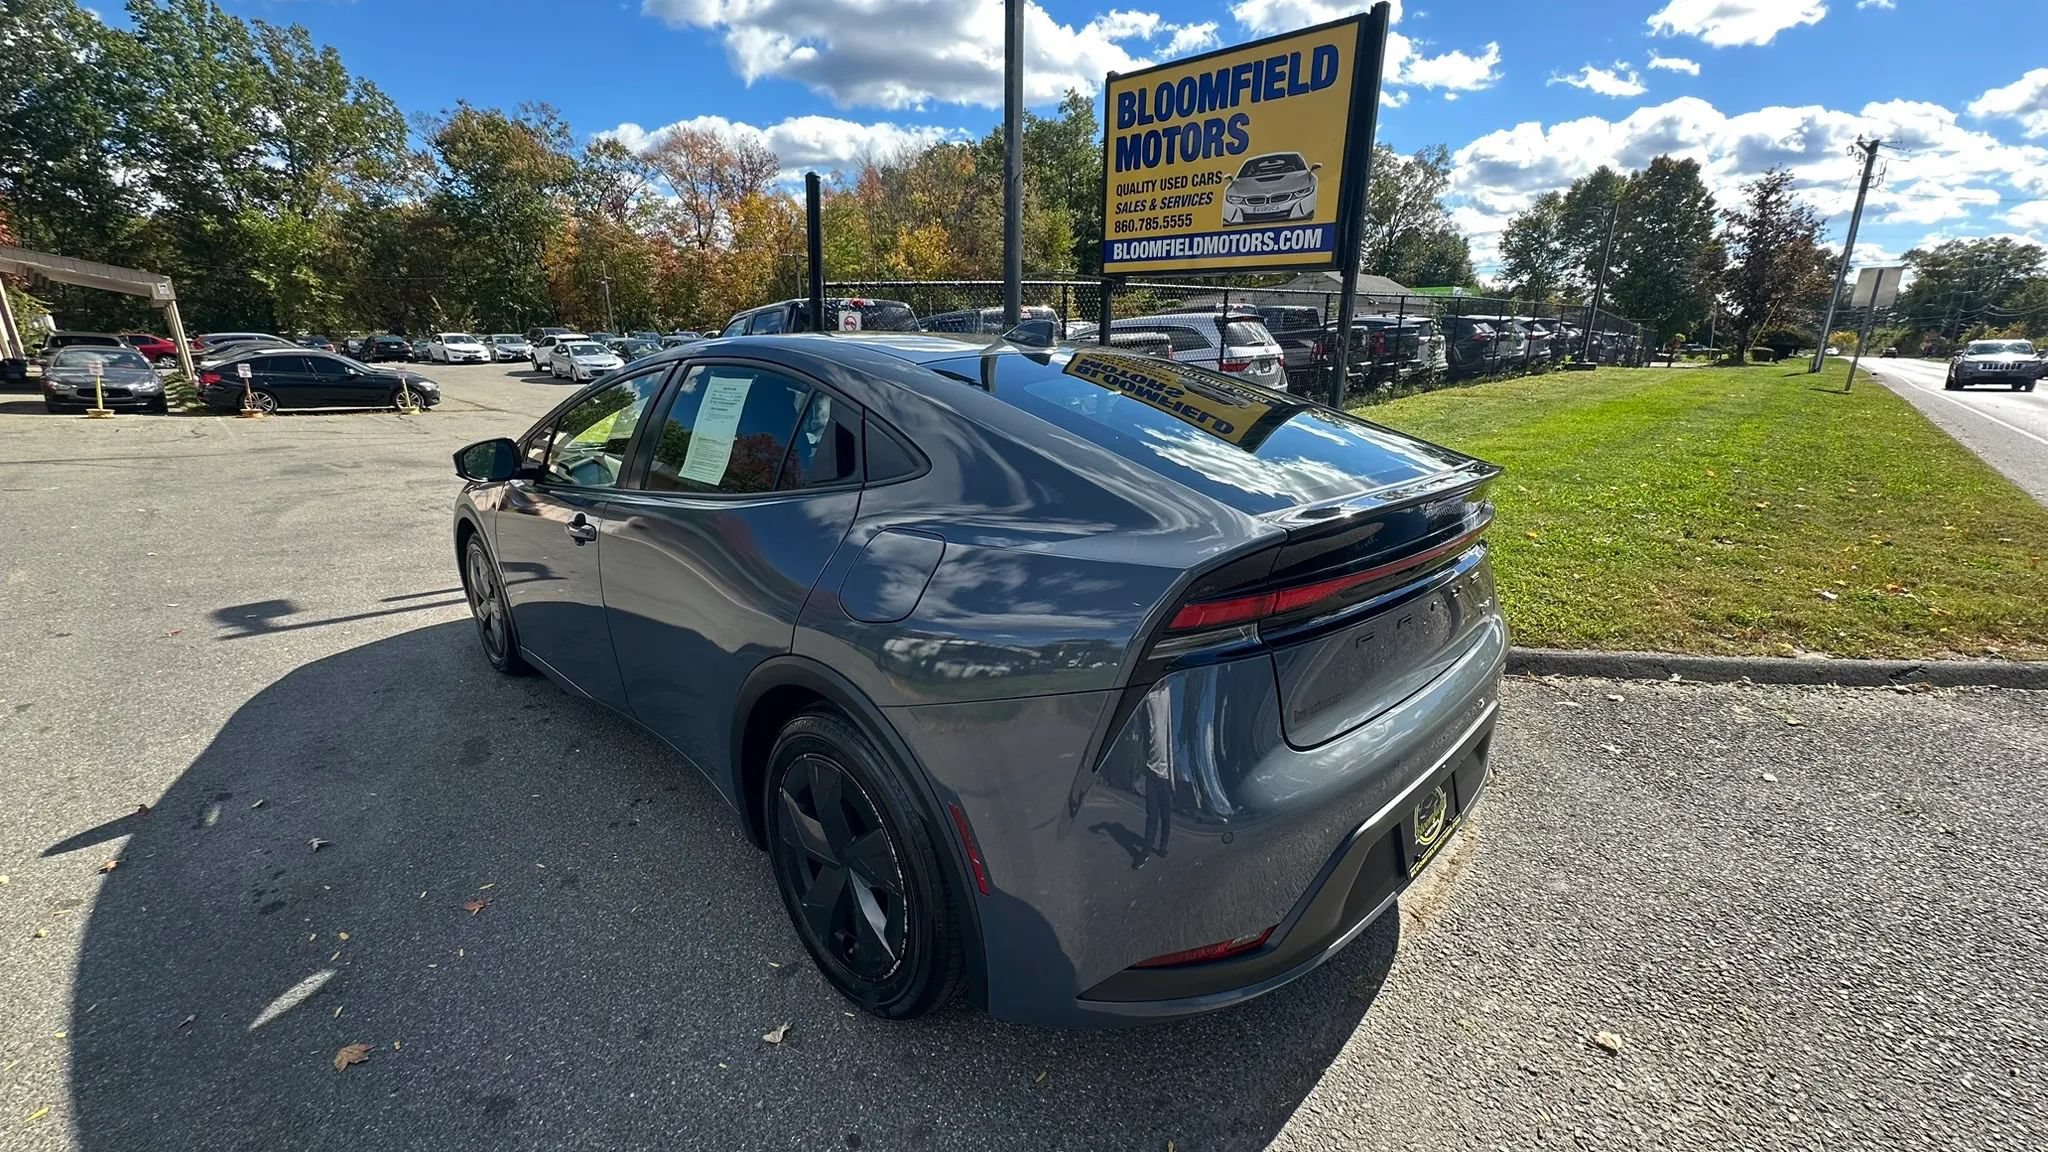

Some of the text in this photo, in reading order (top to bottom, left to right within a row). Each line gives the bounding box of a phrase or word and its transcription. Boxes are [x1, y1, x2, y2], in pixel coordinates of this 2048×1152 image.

[1117, 44, 1339, 130] BLOOMFIELD
[1115, 112, 1250, 173] MOTORS
[1116, 171, 1223, 197] QUALITY USED CARS
[1115, 191, 1214, 215] SALES & SERVICES
[1114, 213, 1193, 233] 860.785.5555
[1113, 228, 1322, 260] BLOOMFIELDMOTORS.COM
